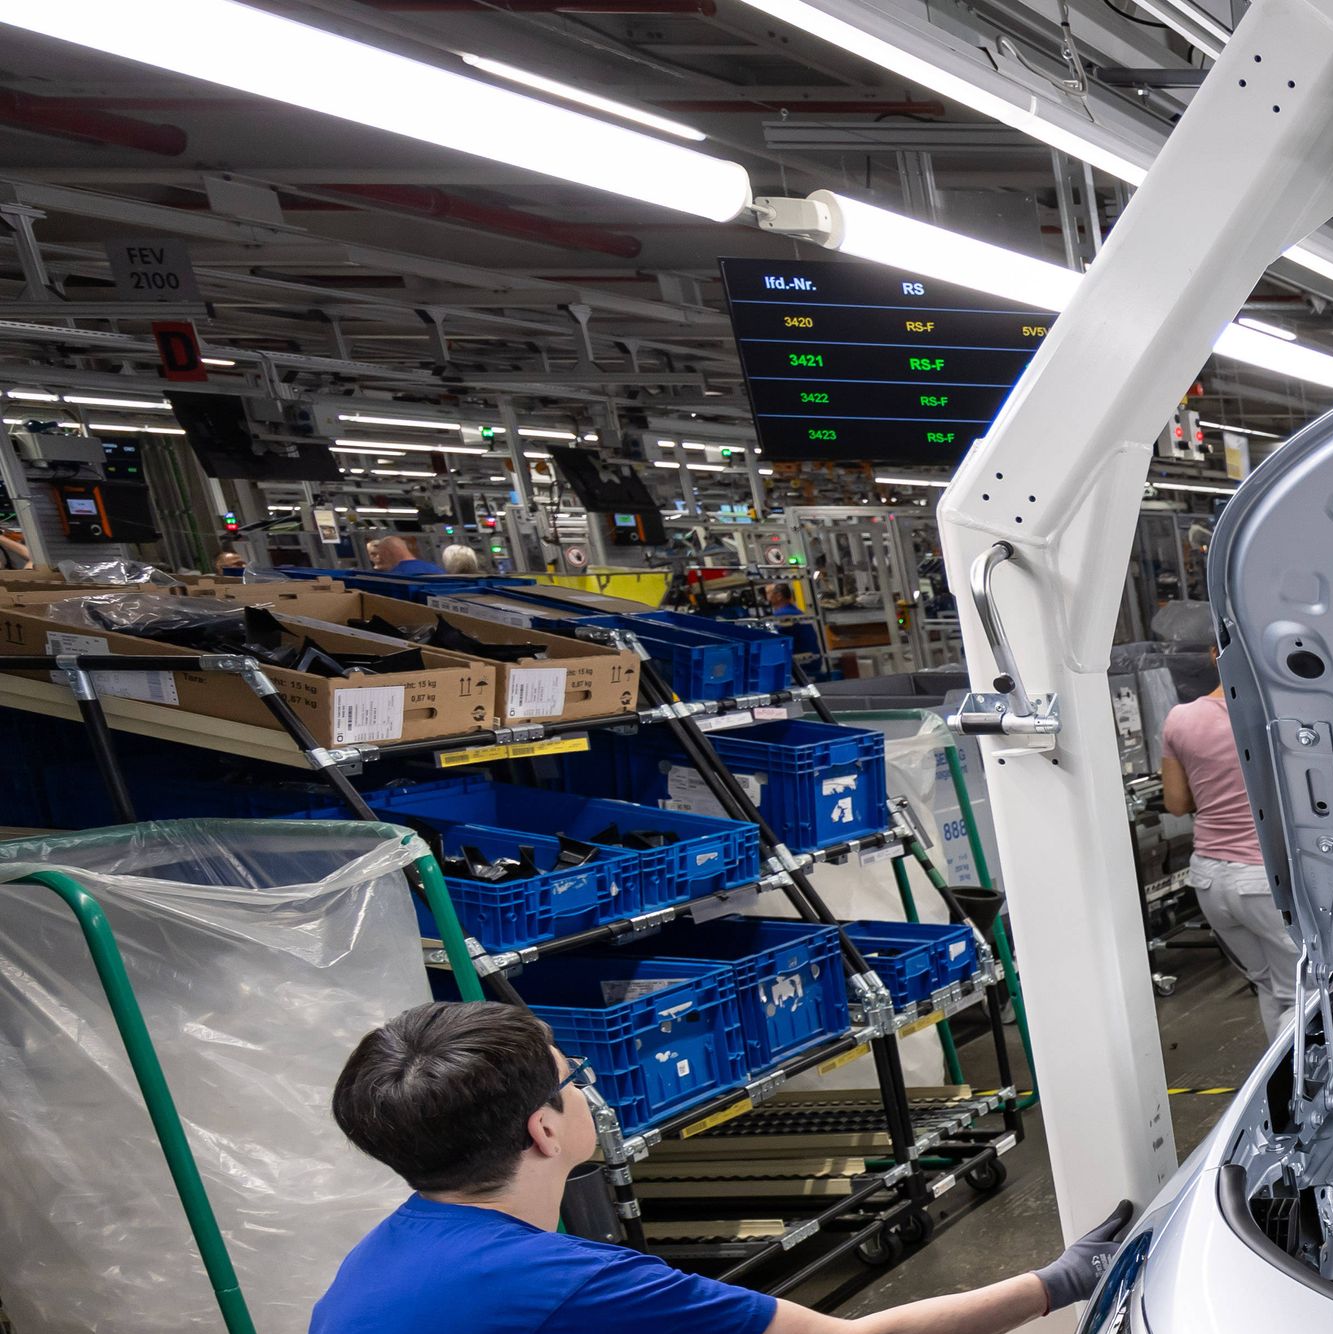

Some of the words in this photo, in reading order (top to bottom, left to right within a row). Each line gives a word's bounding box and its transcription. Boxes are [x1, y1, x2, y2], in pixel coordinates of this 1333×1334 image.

[126, 248, 164, 264] FEV
[130, 272, 179, 289] 2100
[902, 283, 924, 296] RS
[784, 317, 813, 329] 3420
[906, 321, 935, 333] RS-F
[158, 332, 198, 371] D
[789, 355, 824, 367] 3421
[910, 359, 944, 371] RS-F
[801, 393, 829, 404] 3422
[921, 397, 948, 407] RS-F
[809, 430, 836, 440] 3423
[927, 433, 955, 443] RS-F
